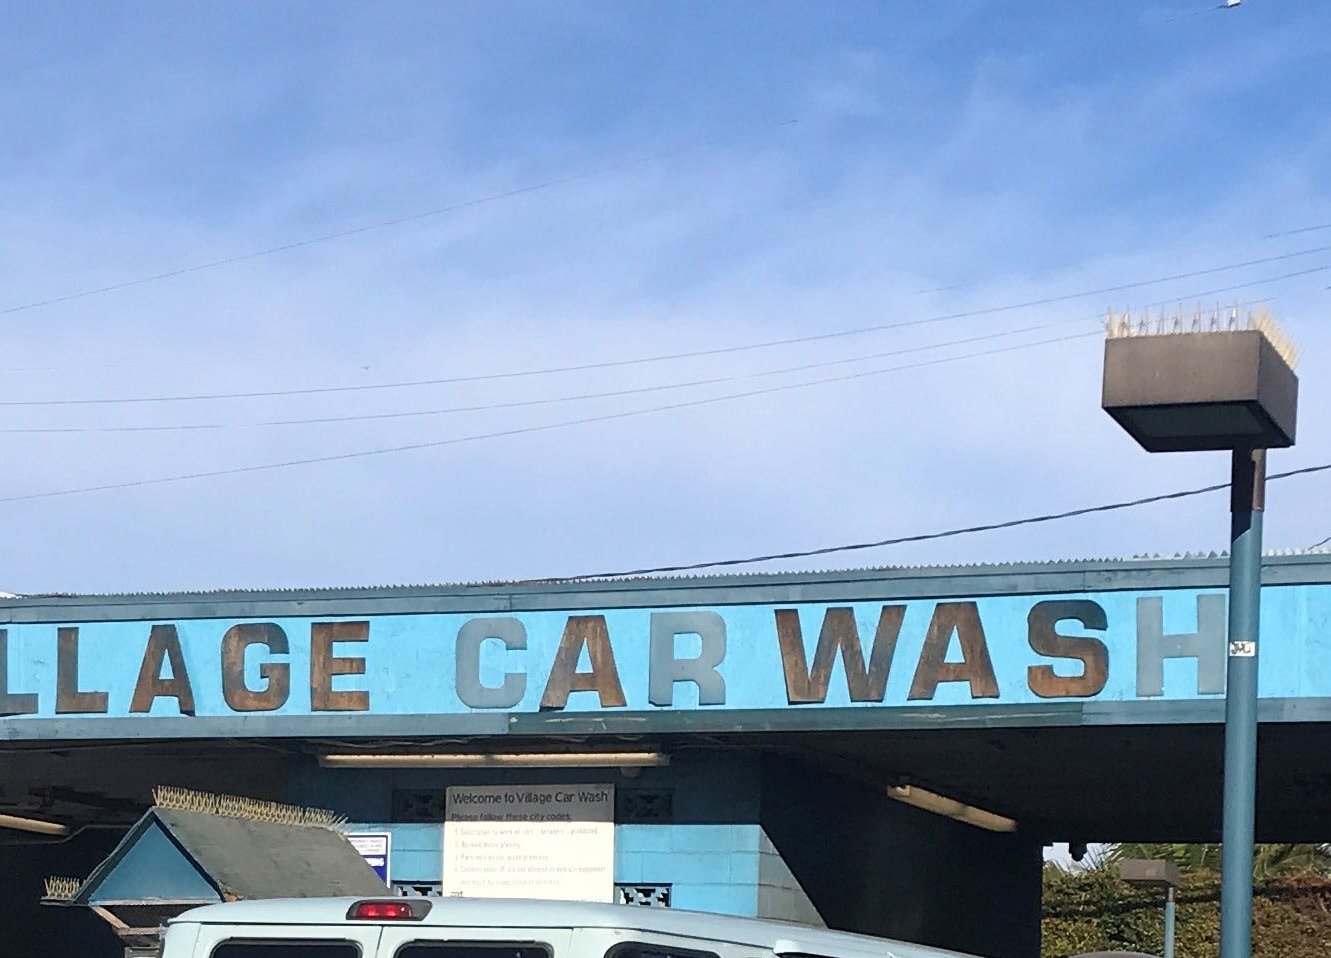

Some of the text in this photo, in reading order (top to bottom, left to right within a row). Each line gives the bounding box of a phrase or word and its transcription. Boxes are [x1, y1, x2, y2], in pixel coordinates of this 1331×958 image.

[455, 611, 727, 711] CAR
[774, 593, 1226, 705] WASH
[452, 792, 502, 804] Welcome
[515, 791, 552, 806] Village
[554, 791, 574, 803] Car
[578, 791, 608, 803] Wash
